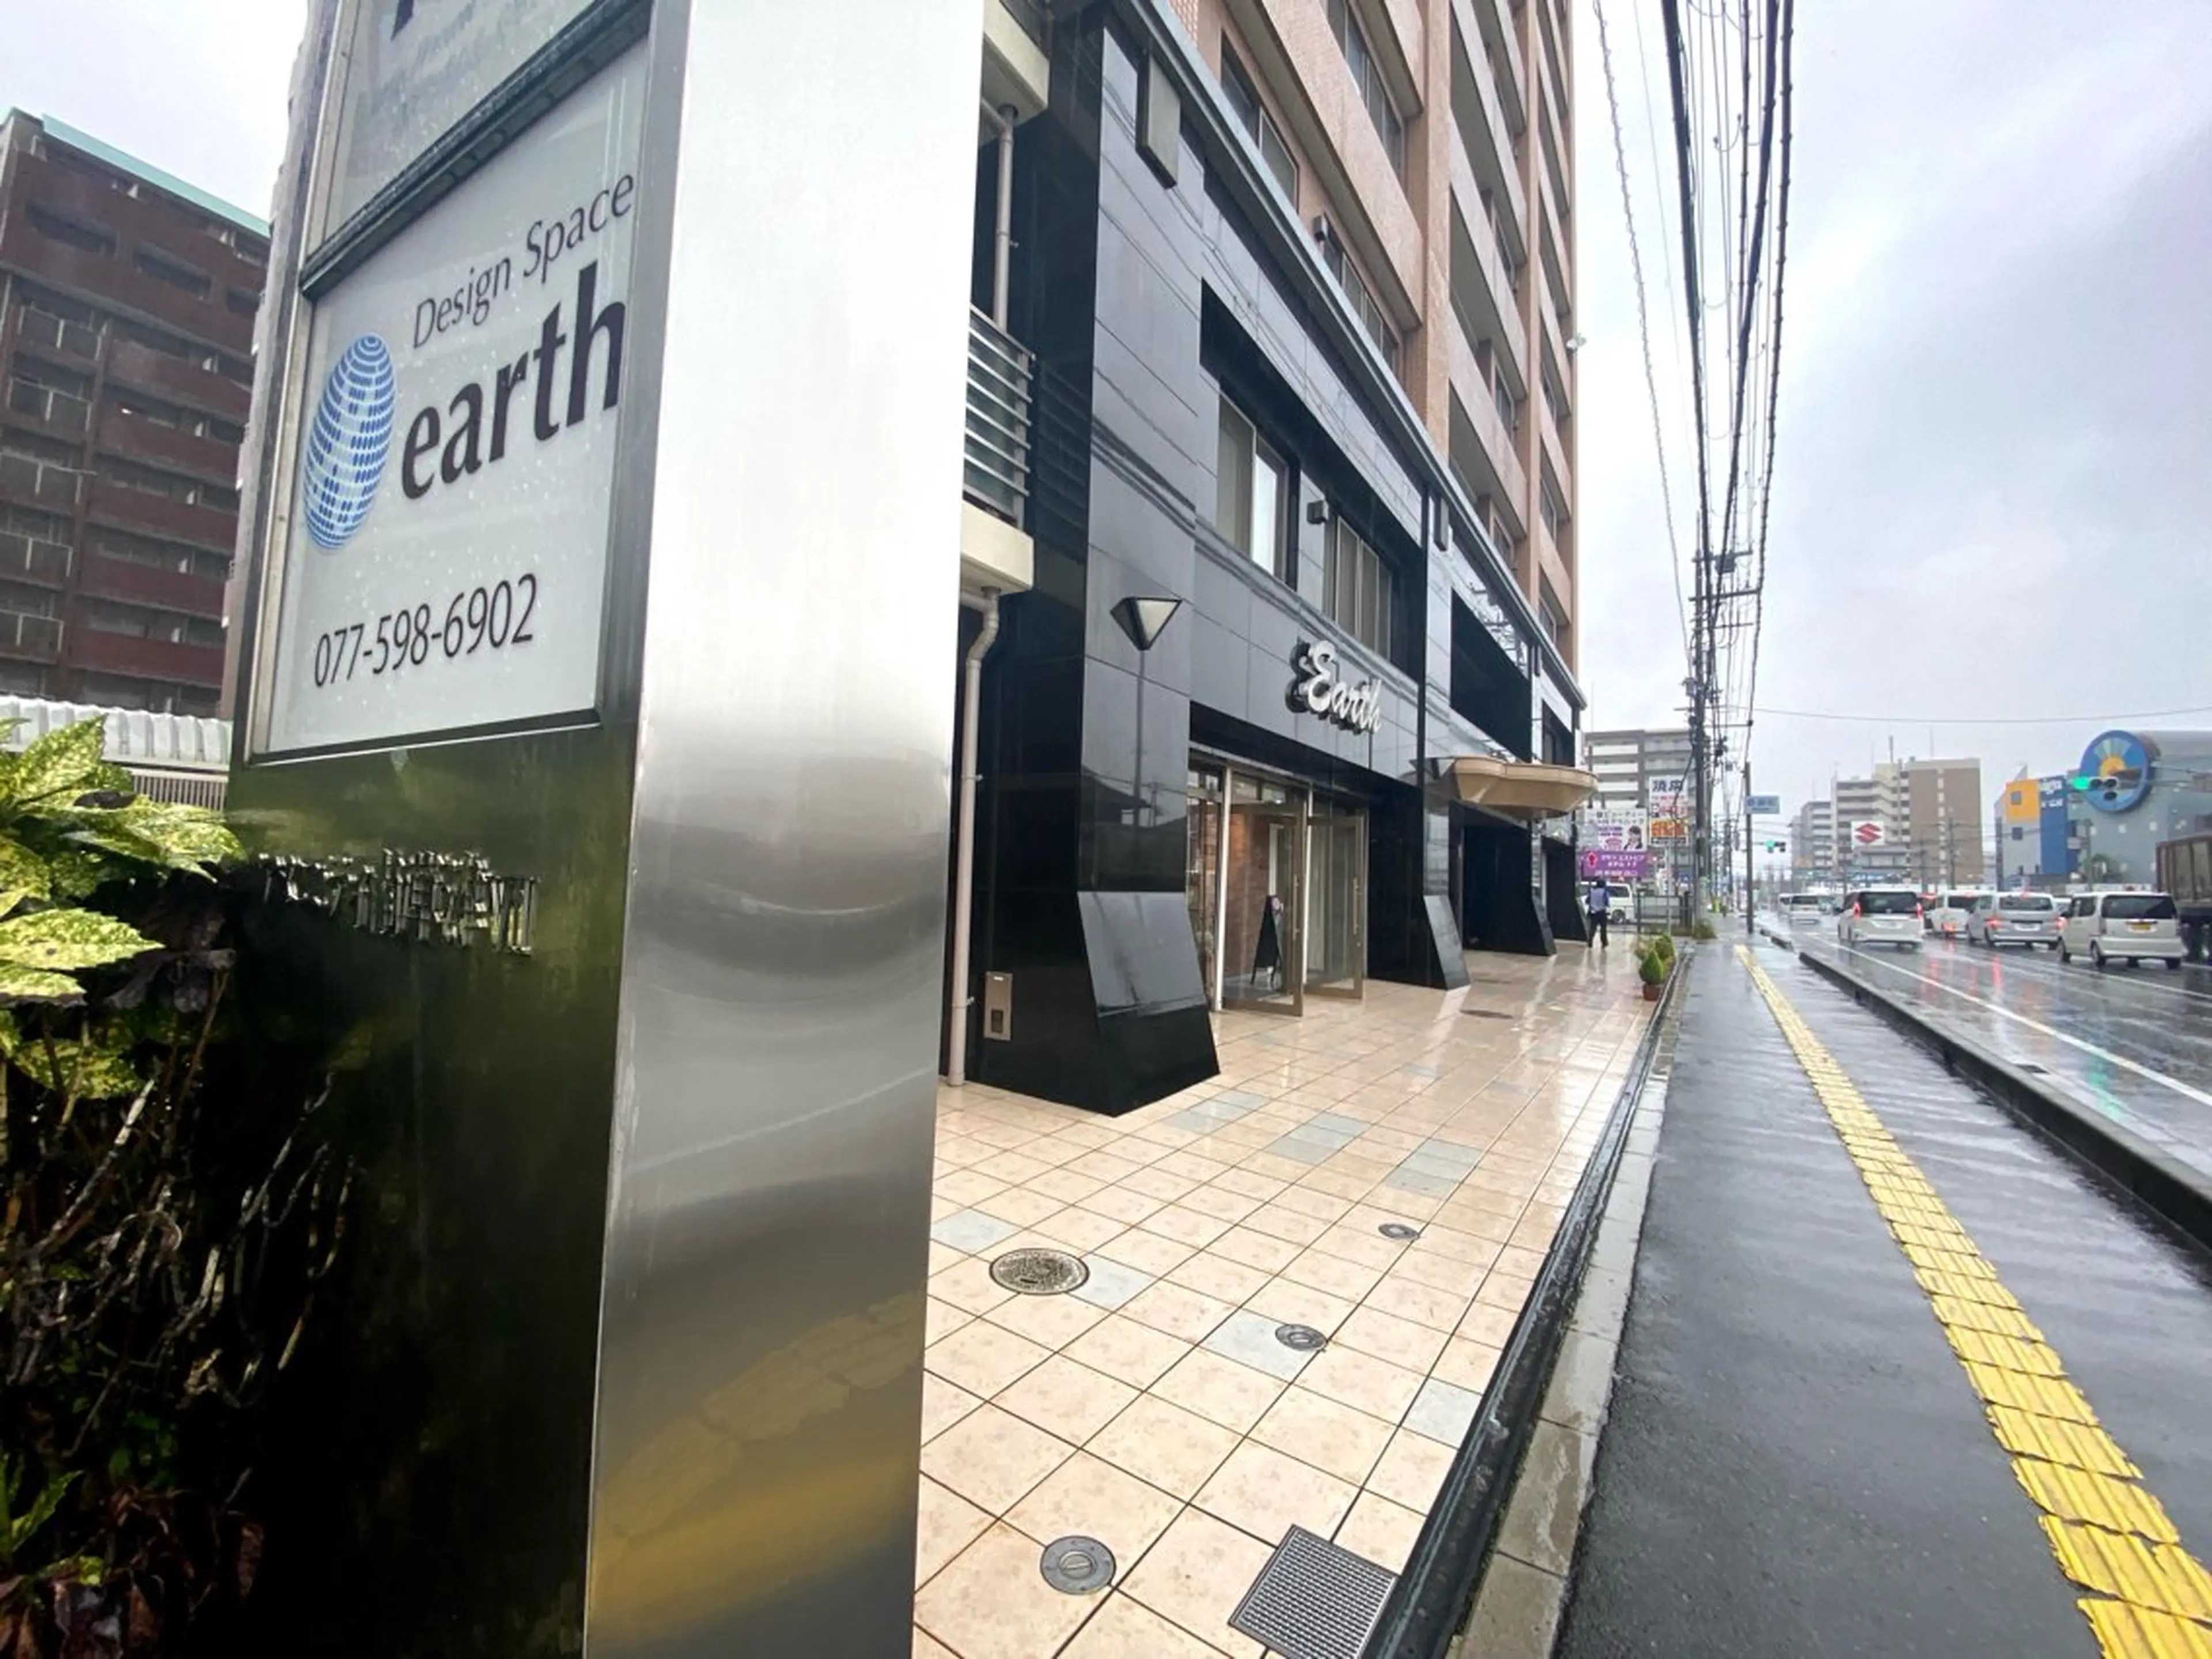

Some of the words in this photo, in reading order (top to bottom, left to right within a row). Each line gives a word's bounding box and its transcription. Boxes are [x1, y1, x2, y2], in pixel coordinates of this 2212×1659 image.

[413, 256, 512, 349] Design
[523, 173, 634, 285] Space
[402, 259, 626, 500] earth
[313, 573, 538, 688] 077-598-6902
[1298, 639, 1382, 733] Earth
